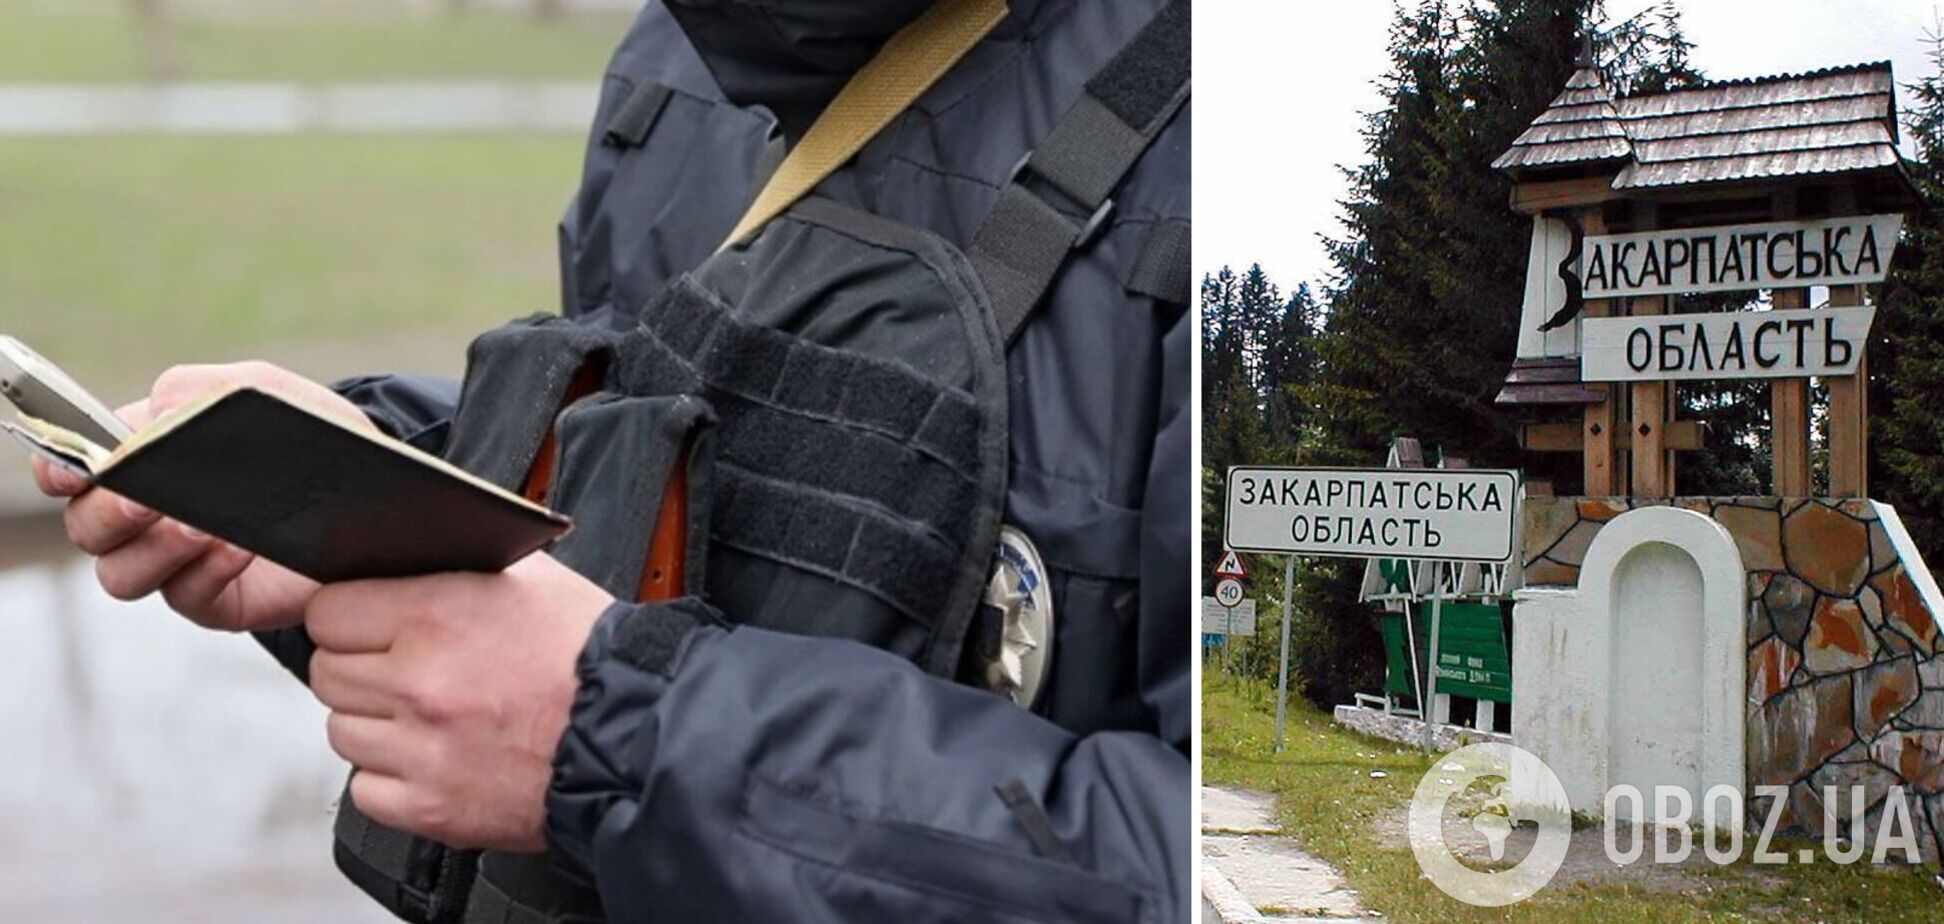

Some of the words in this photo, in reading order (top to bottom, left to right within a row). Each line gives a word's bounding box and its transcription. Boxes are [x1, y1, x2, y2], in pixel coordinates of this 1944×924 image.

[1626, 317, 1852, 372] ОБЛАСТЬ
[1239, 478, 1502, 511] ЗАКАРПАТСЬКА
[1292, 515, 1441, 547] ОБЛАСТЬ
[1221, 586, 1238, 599] 40
